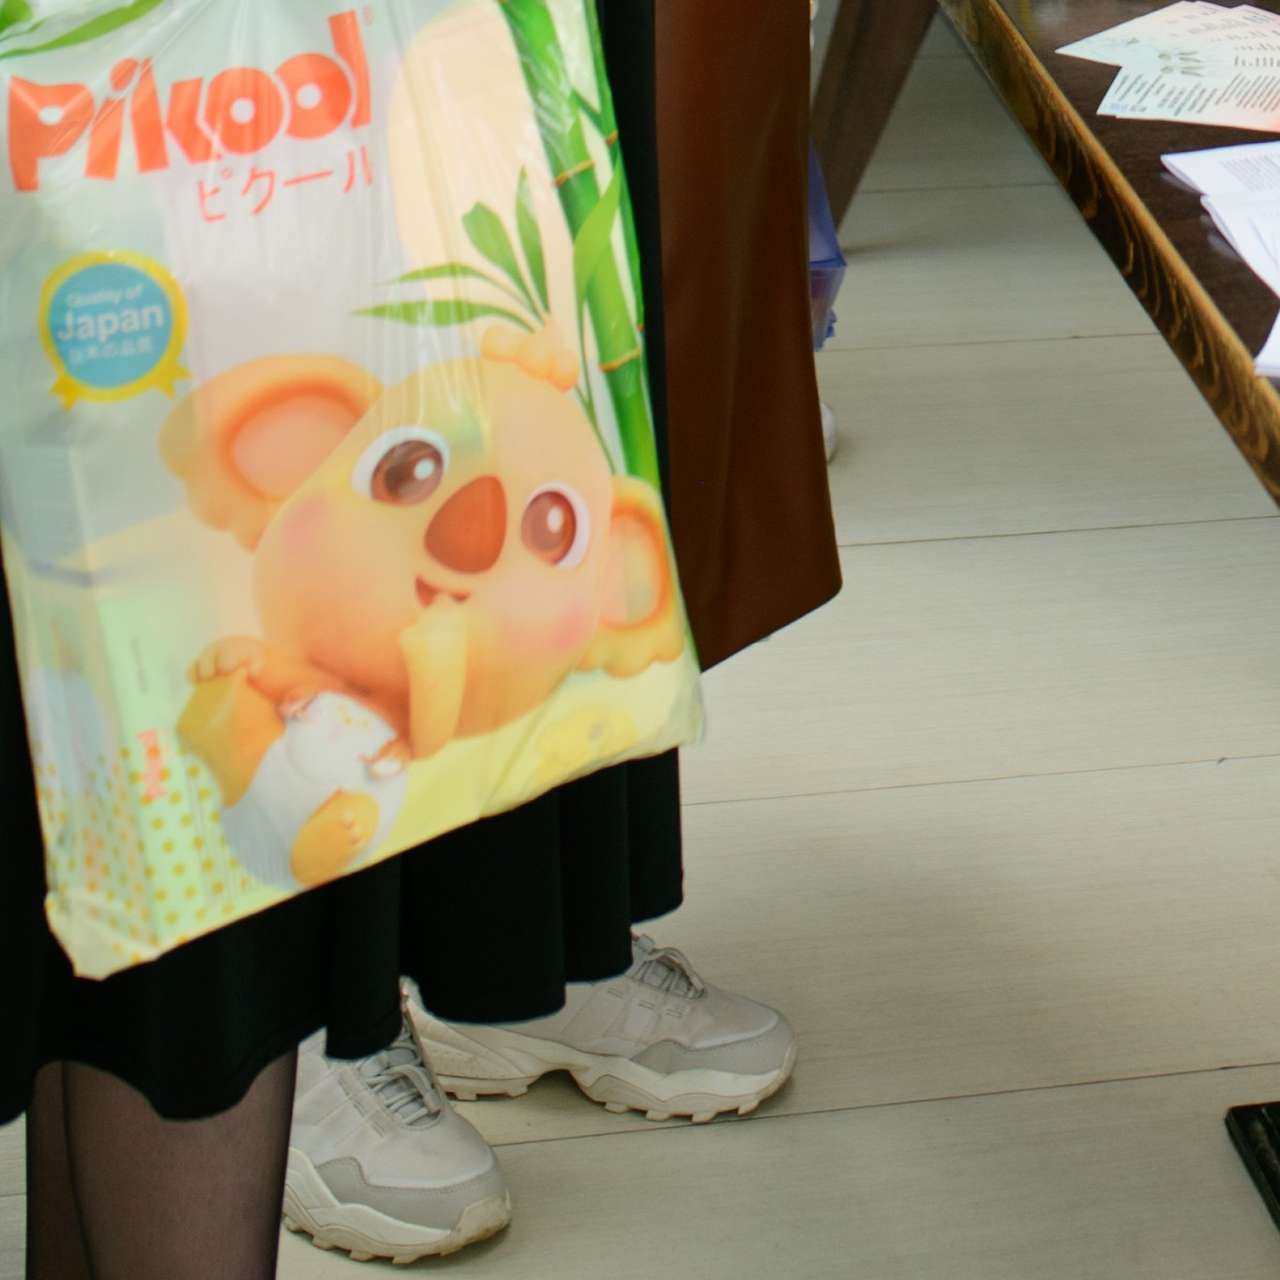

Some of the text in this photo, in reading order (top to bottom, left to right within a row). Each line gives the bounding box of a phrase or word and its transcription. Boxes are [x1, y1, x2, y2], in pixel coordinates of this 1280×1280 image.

[7, 10, 371, 193] Pikool
[197, 145, 373, 222] ピクール
[58, 304, 164, 343] Japan
